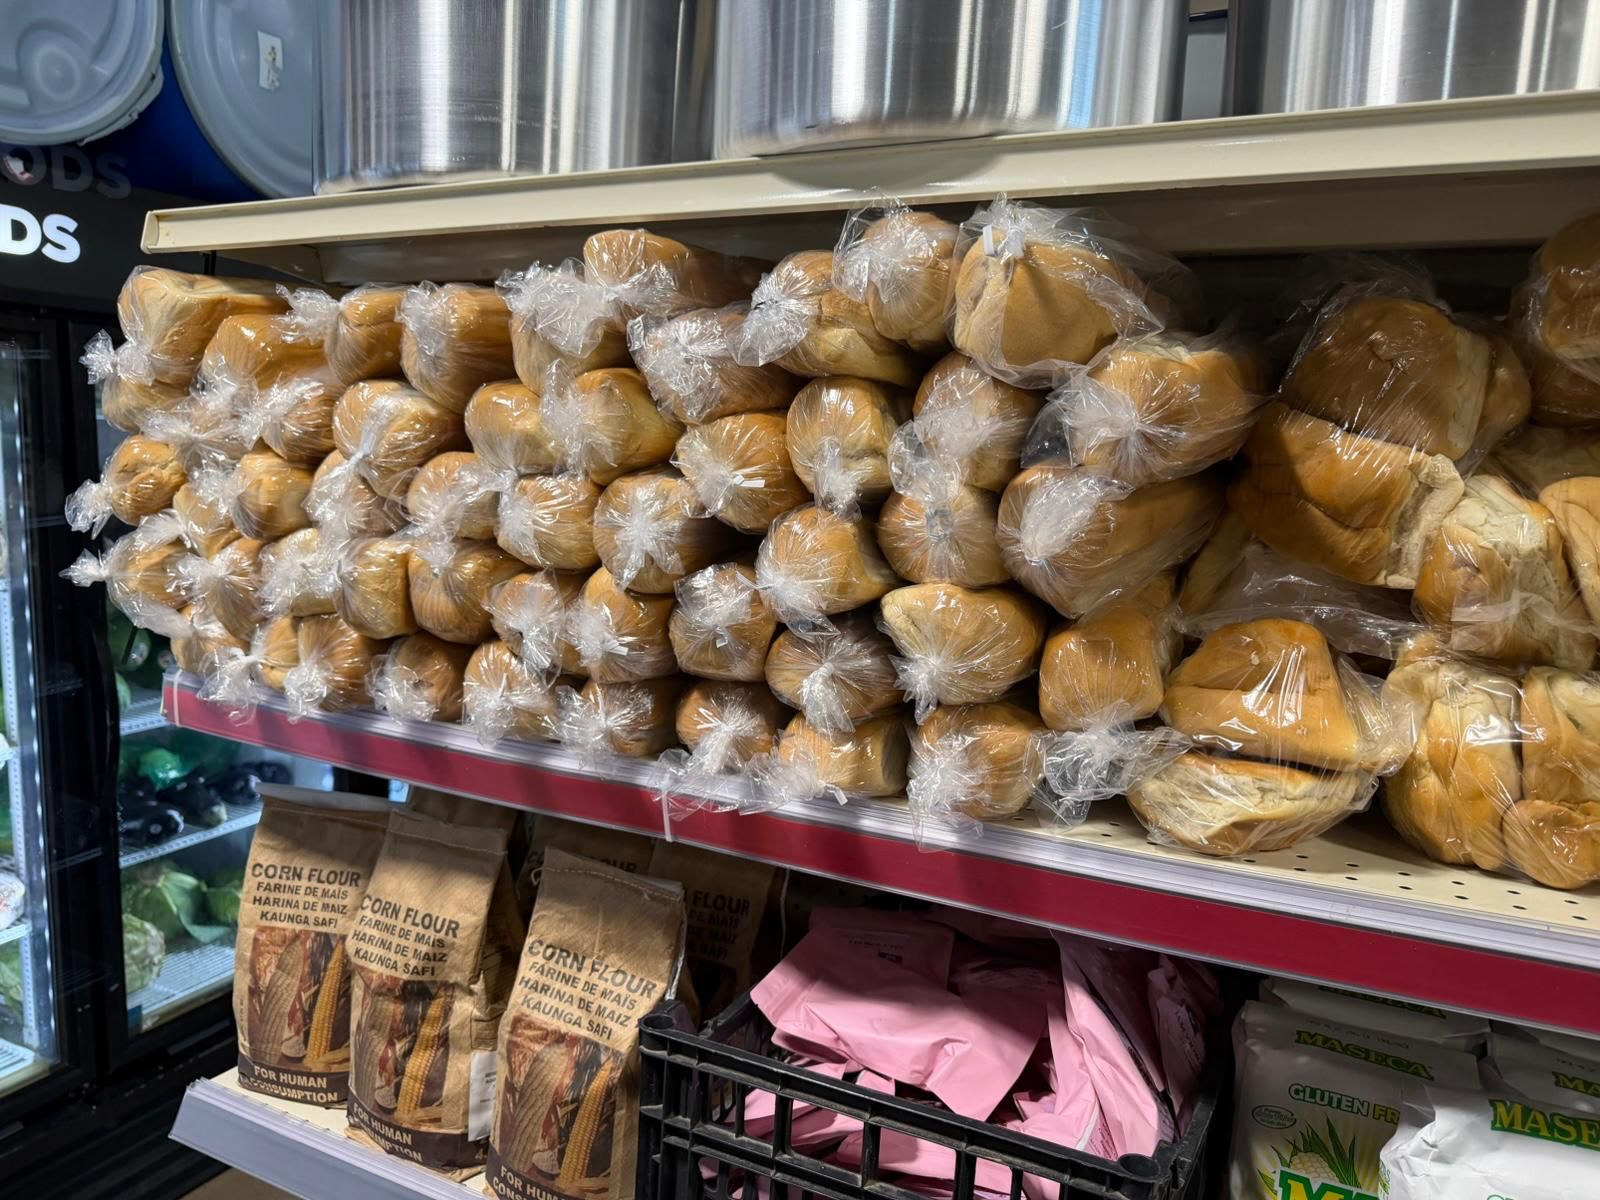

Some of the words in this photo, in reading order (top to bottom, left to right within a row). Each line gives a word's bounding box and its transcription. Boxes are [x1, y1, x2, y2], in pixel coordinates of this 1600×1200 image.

[251, 863, 304, 882] CORN
[307, 868, 361, 887] FLOUR
[256, 881, 302, 896] FARINE
[304, 886, 319, 897] DE
[252, 895, 300, 910] HARINA
[303, 900, 319, 912] DE
[321, 902, 348, 915] MAIZ
[260, 910, 310, 926] KAUNGA
[313, 917, 338, 929] SAFI
[360, 894, 402, 920] CORN
[403, 907, 460, 938] FLOUR
[358, 915, 397, 936] FARINE
[398, 927, 412, 941] DE
[351, 929, 393, 953] HARINA
[394, 943, 410, 957] DE
[412, 948, 448, 962] MAIZ
[353, 947, 398, 972] KAUNGA
[402, 962, 436, 977] SAFI
[528, 939, 586, 973] CORN
[588, 958, 657, 999] FLOUR
[528, 961, 582, 989] FARINE
[581, 980, 599, 996] DE
[518, 975, 574, 1007] HARINA
[577, 997, 594, 1014] DE
[595, 1003, 632, 1028] MAIZ
[521, 994, 582, 1028] KAUNGA
[586, 1019, 613, 1040] SAFI
[1295, 1030, 1434, 1081] MASECA
[254, 1066, 277, 1081] FOR
[279, 1072, 327, 1088] HUMAN
[1288, 1083, 1370, 1117] GLUTEN
[353, 1103, 370, 1124] FOR
[371, 1118, 412, 1146] HUMAN
[501, 1165, 522, 1191] FOR
